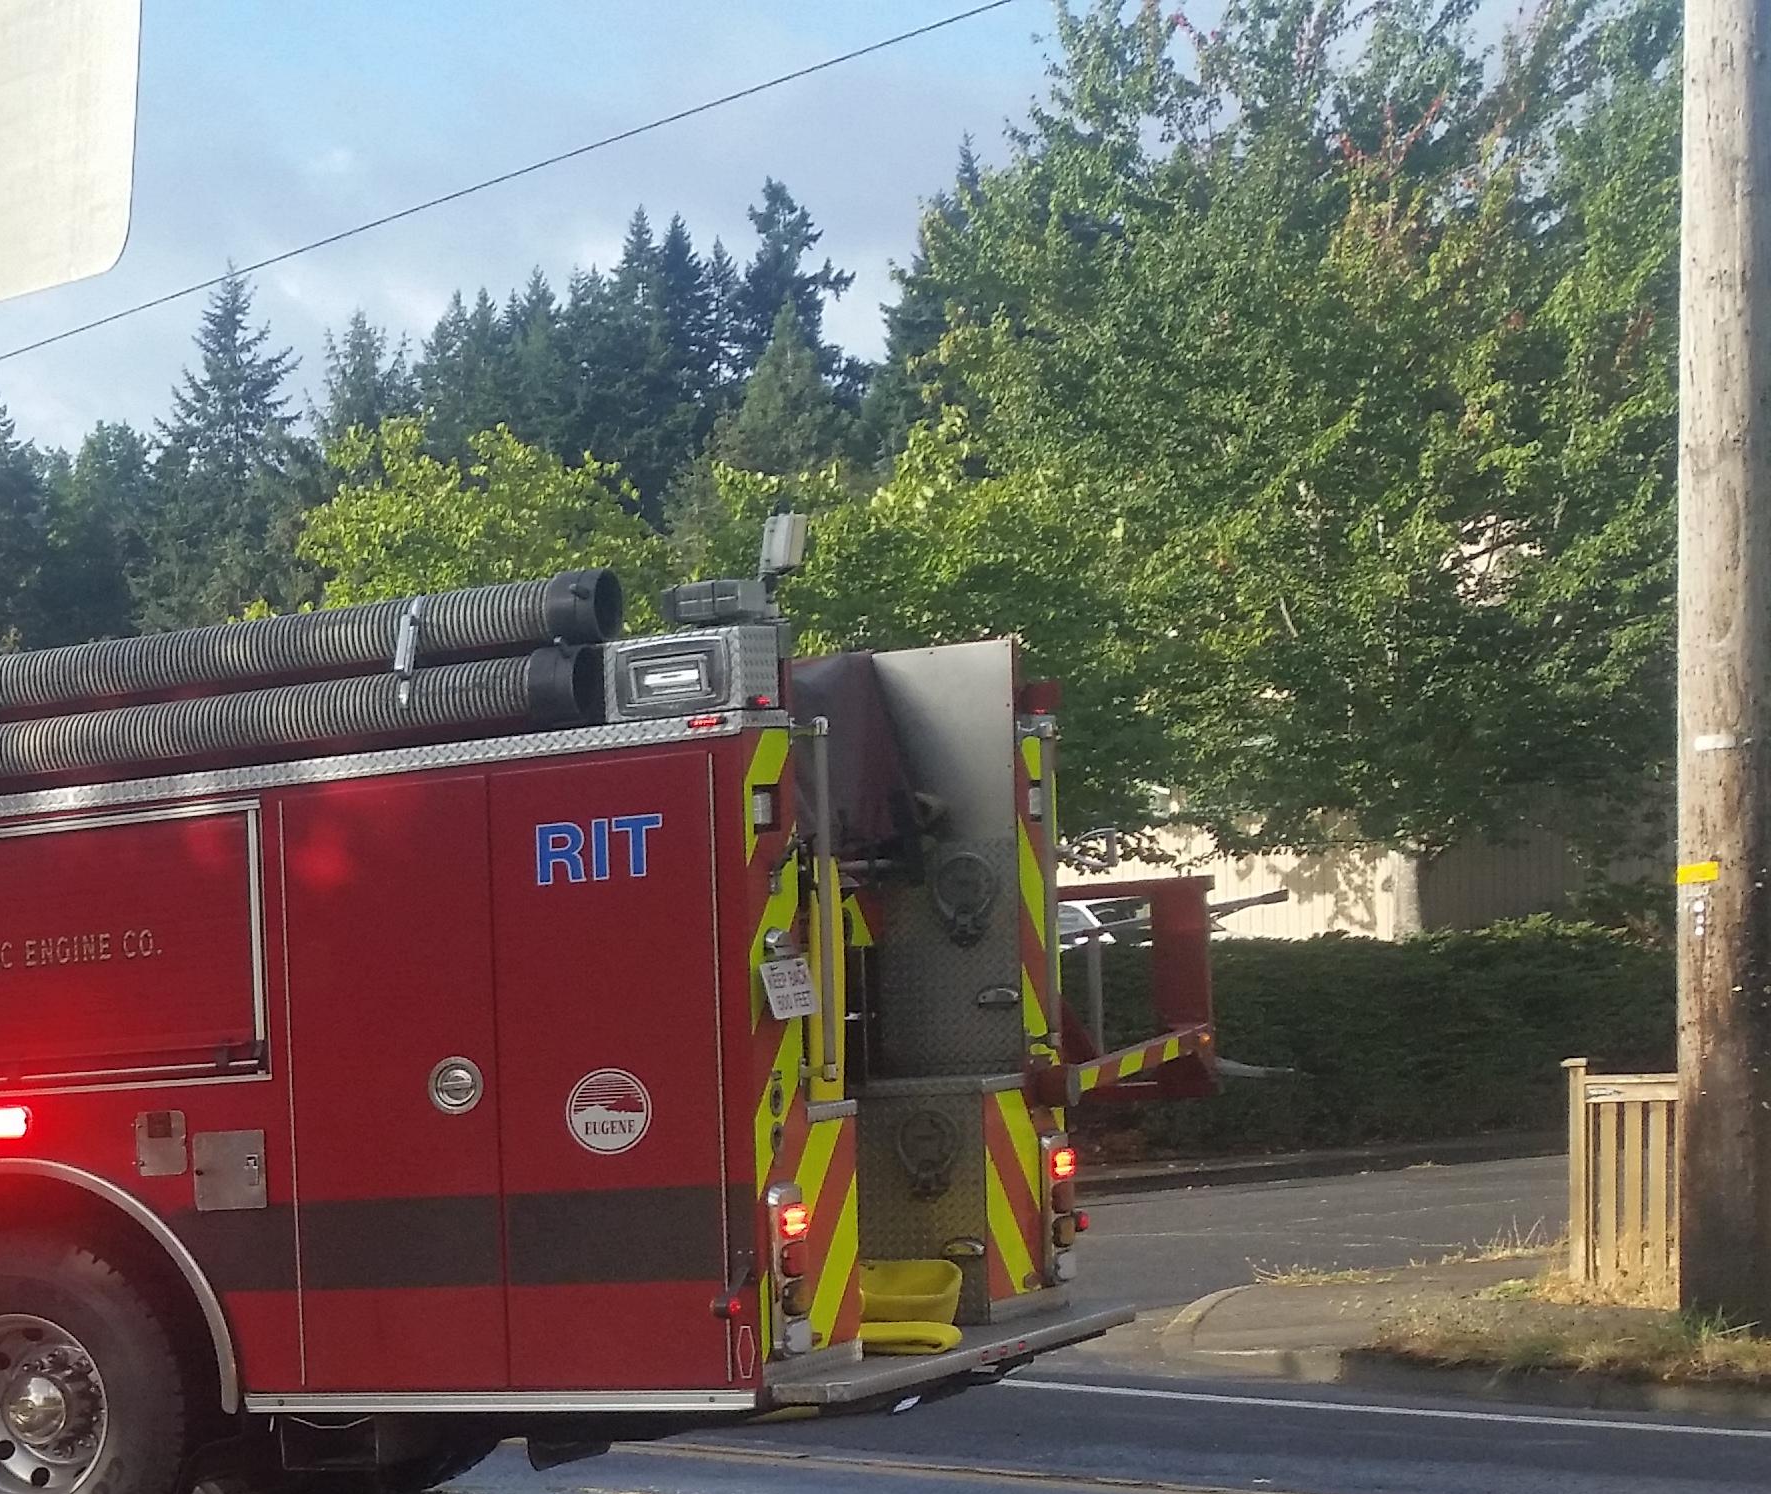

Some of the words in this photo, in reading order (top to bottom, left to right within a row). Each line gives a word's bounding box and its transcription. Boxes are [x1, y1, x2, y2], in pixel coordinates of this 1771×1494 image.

[535, 813, 663, 886] RIT
[25, 933, 111, 967] ENGINE
[122, 929, 163, 959] CO.
[584, 1119, 636, 1135] EUGENE
